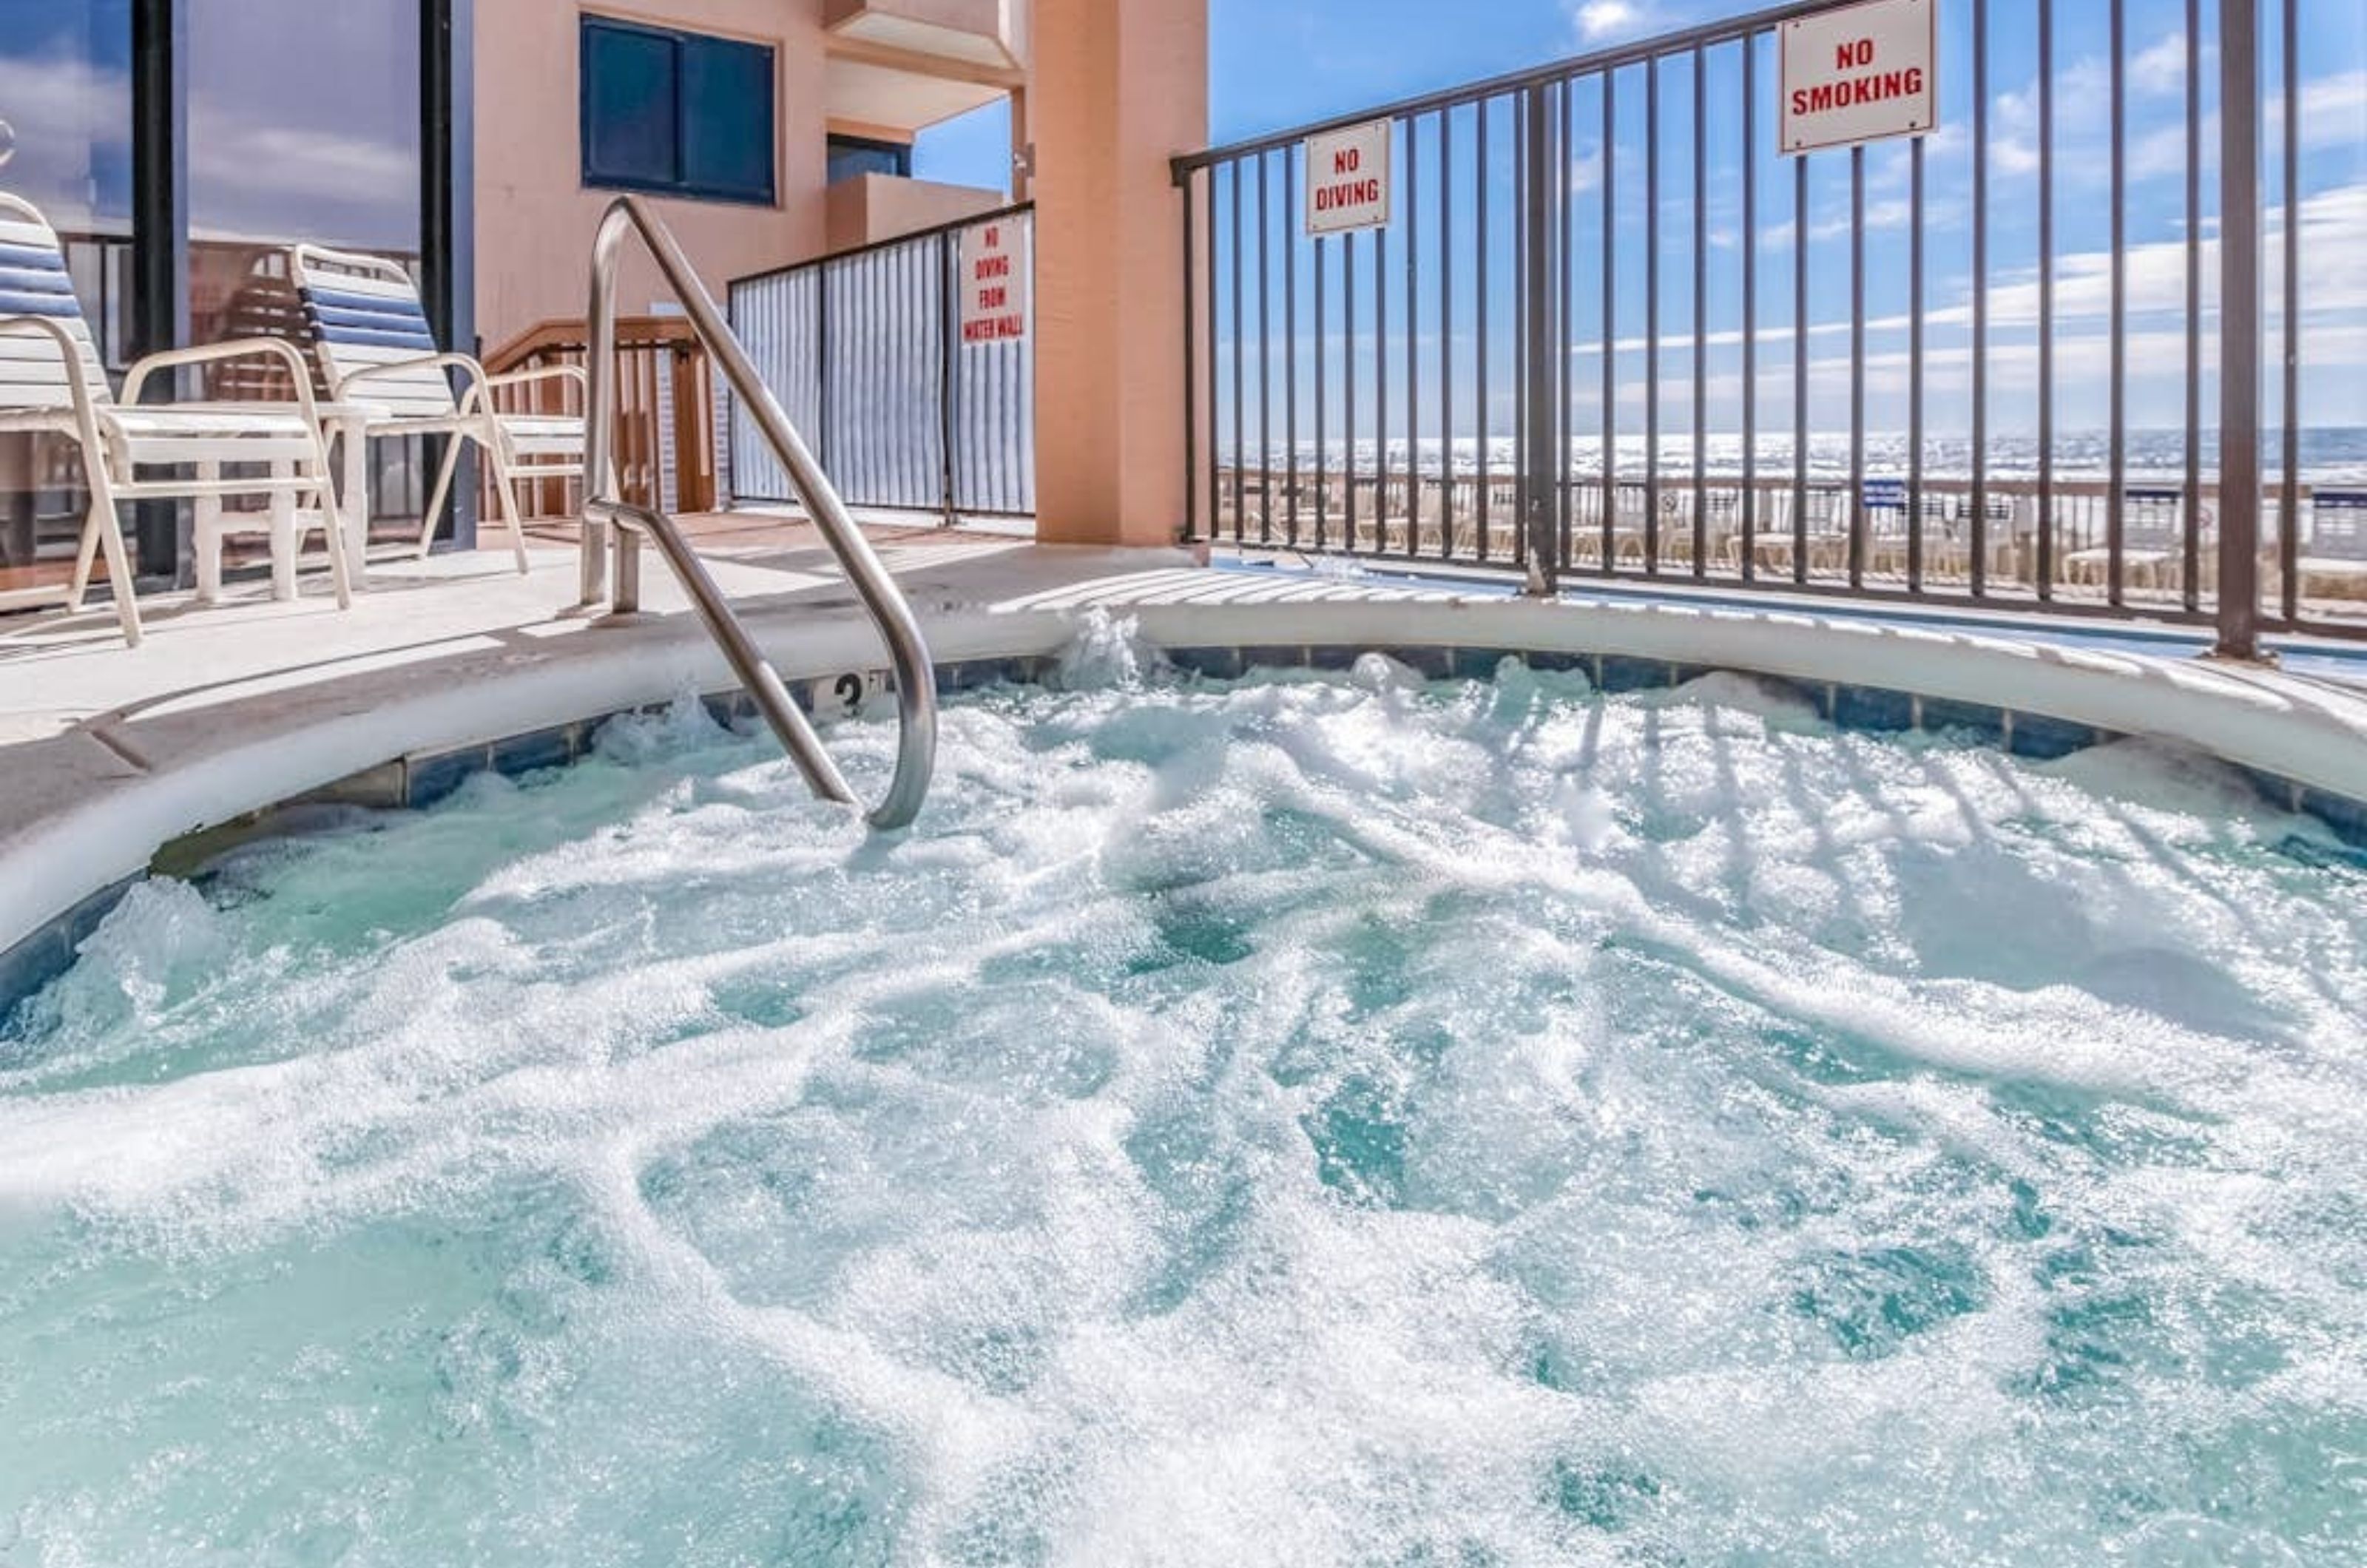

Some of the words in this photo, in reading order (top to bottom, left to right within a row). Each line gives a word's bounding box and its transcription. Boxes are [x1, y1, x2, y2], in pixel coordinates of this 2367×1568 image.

[1836, 38, 1873, 69] NO
[1792, 67, 1922, 115] SMOKING
[1335, 149, 1358, 174] NO
[1317, 179, 1378, 210] DIVING
[985, 227, 998, 247] NO
[976, 256, 1008, 280] DIVING
[980, 287, 1005, 309] FROM
[964, 318, 994, 342] WATER
[999, 313, 1022, 337] WALL
